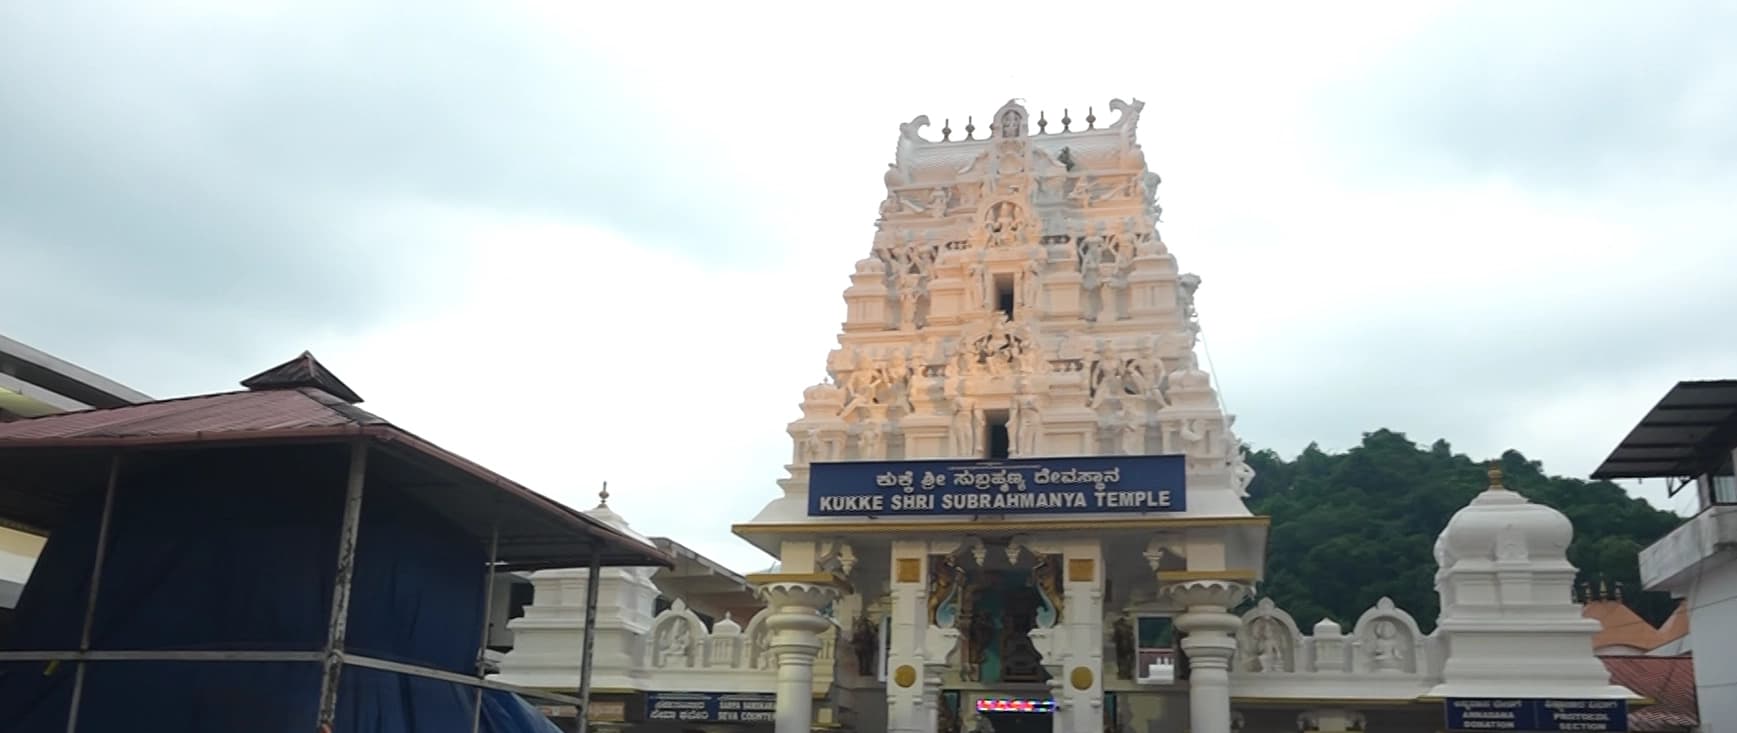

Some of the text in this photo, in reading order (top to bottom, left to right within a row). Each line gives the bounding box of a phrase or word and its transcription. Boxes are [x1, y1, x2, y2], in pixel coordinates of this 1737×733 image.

[876, 467, 1121, 493] ಕುಕ್ಕೆ ಶ್ರೀ ಸುಬ್ರಹ್ಮಣ್ಯ ದೇವಸ್ಥಾನ
[819, 489, 1171, 512] KUKKE SHRI SUBRAHMANYA TEMPLE
[1553, 713, 1611, 721] PROTOCOL
[1559, 722, 1608, 730] SECTION
